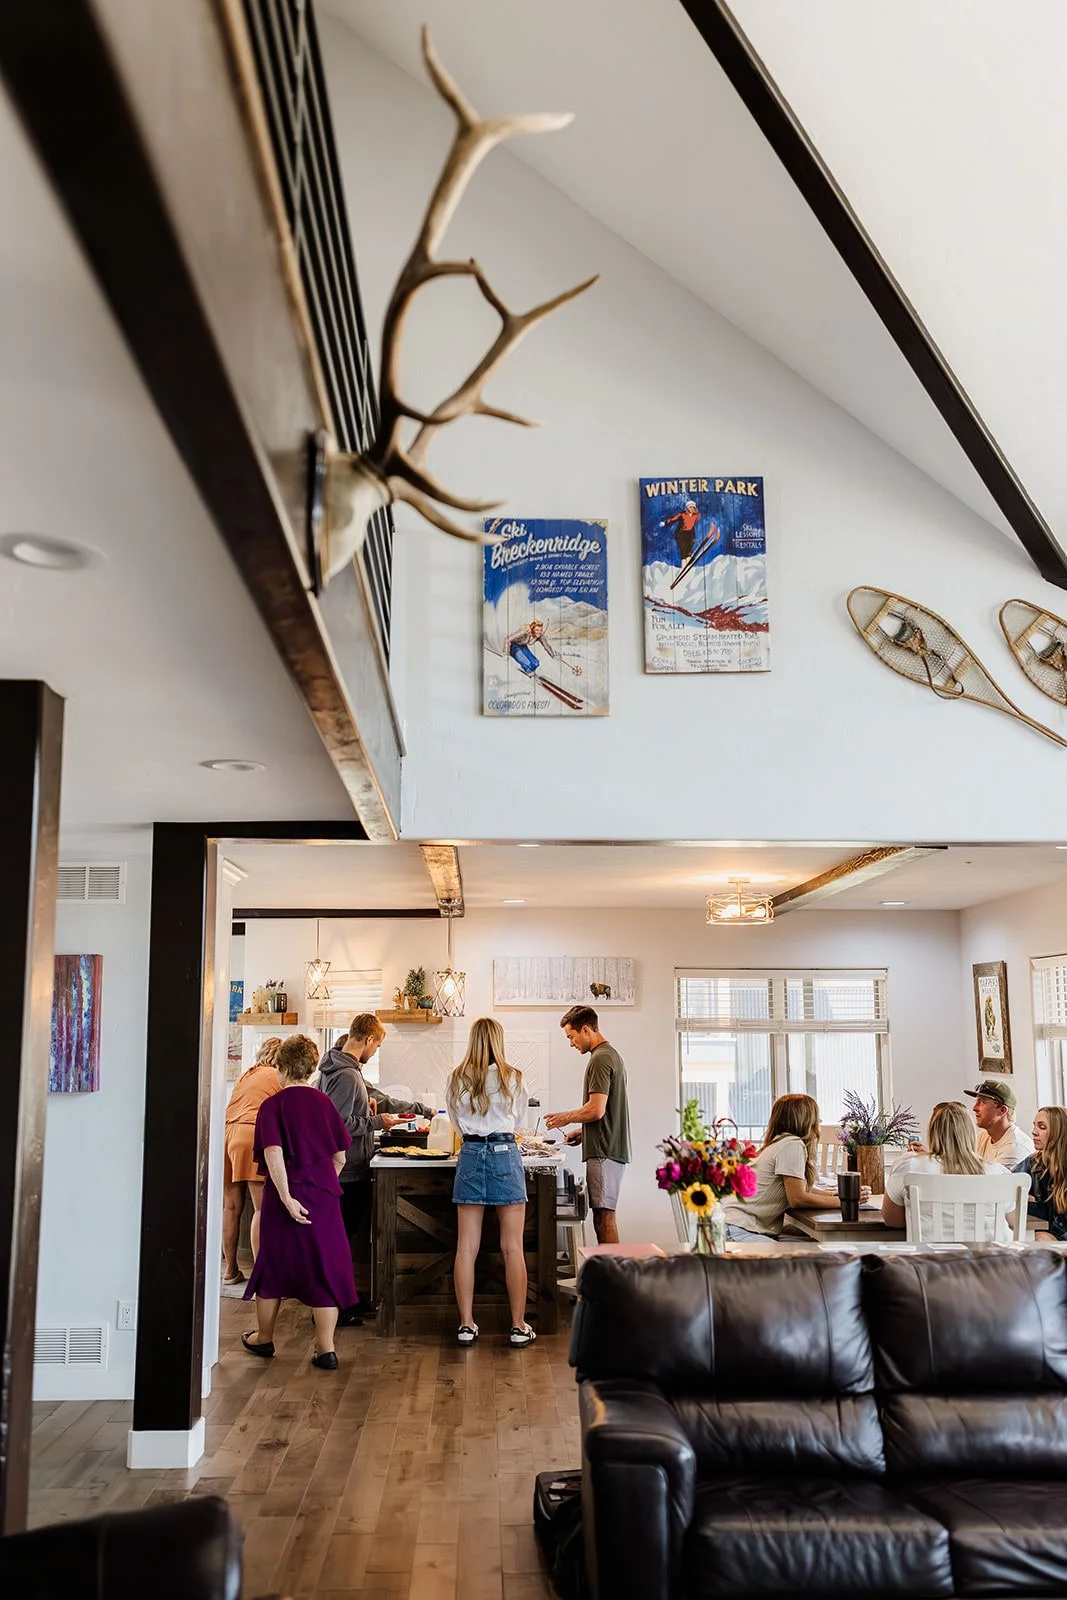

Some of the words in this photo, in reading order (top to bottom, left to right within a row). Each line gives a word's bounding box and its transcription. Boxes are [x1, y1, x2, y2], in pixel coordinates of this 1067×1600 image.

[646, 479, 709, 497] WINTER
[715, 479, 758, 497] PARK
[501, 521, 527, 540] Ski
[491, 532, 601, 569] Breckenridge
